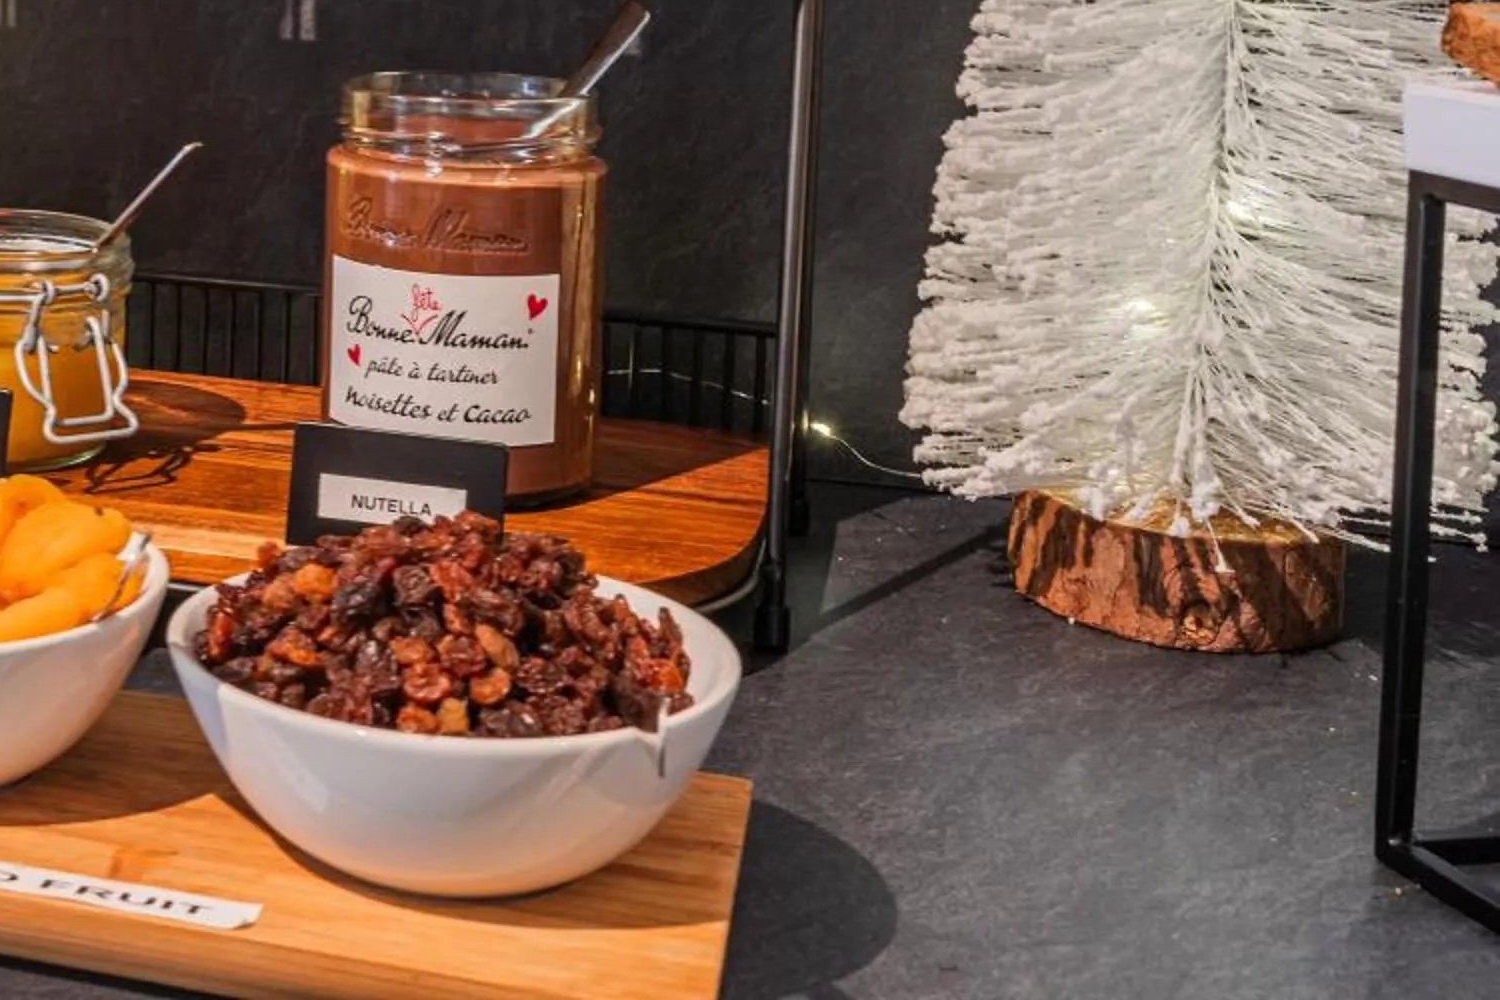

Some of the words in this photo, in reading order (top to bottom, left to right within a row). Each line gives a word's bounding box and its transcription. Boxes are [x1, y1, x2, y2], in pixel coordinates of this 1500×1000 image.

[346, 295, 414, 344] Bonne
[364, 357, 403, 379] pâte
[407, 361, 422, 380] à
[426, 363, 499, 386] tartiner
[437, 403, 460, 423] et
[351, 494, 432, 517] NUTELLA
[39, 878, 217, 916] FRUIT
